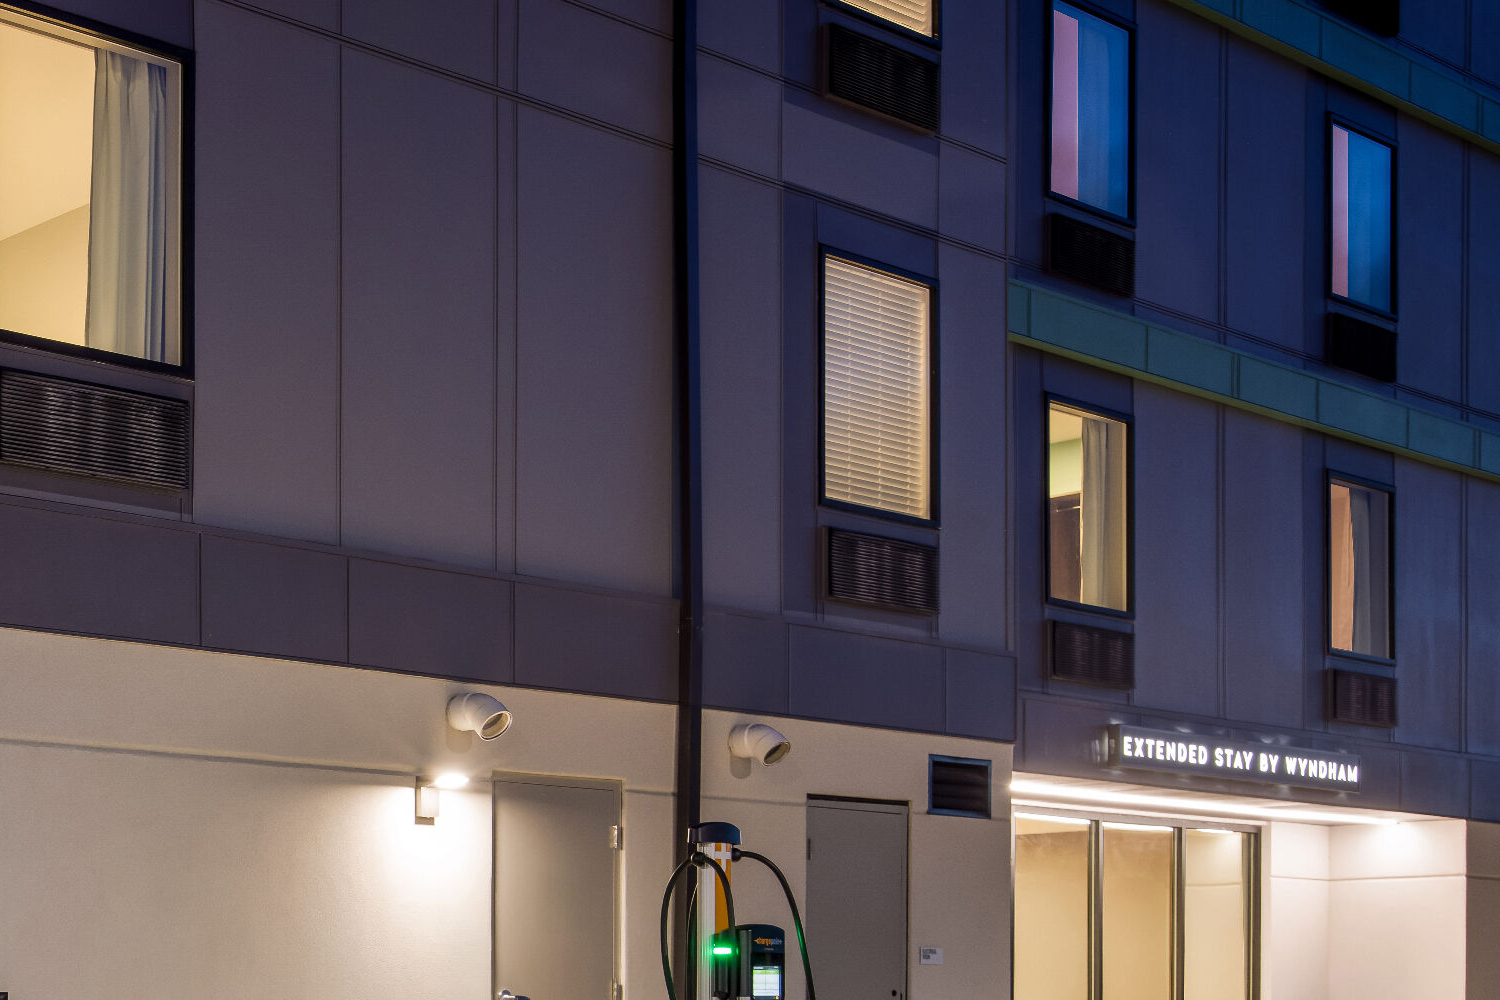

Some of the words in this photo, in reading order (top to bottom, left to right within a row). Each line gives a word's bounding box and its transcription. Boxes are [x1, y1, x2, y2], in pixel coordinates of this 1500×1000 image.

[1123, 736, 1208, 765] EXTENDED
[1214, 748, 1254, 771] STAY
[1259, 753, 1280, 774] BY
[1285, 756, 1359, 783] WYNDHAM
